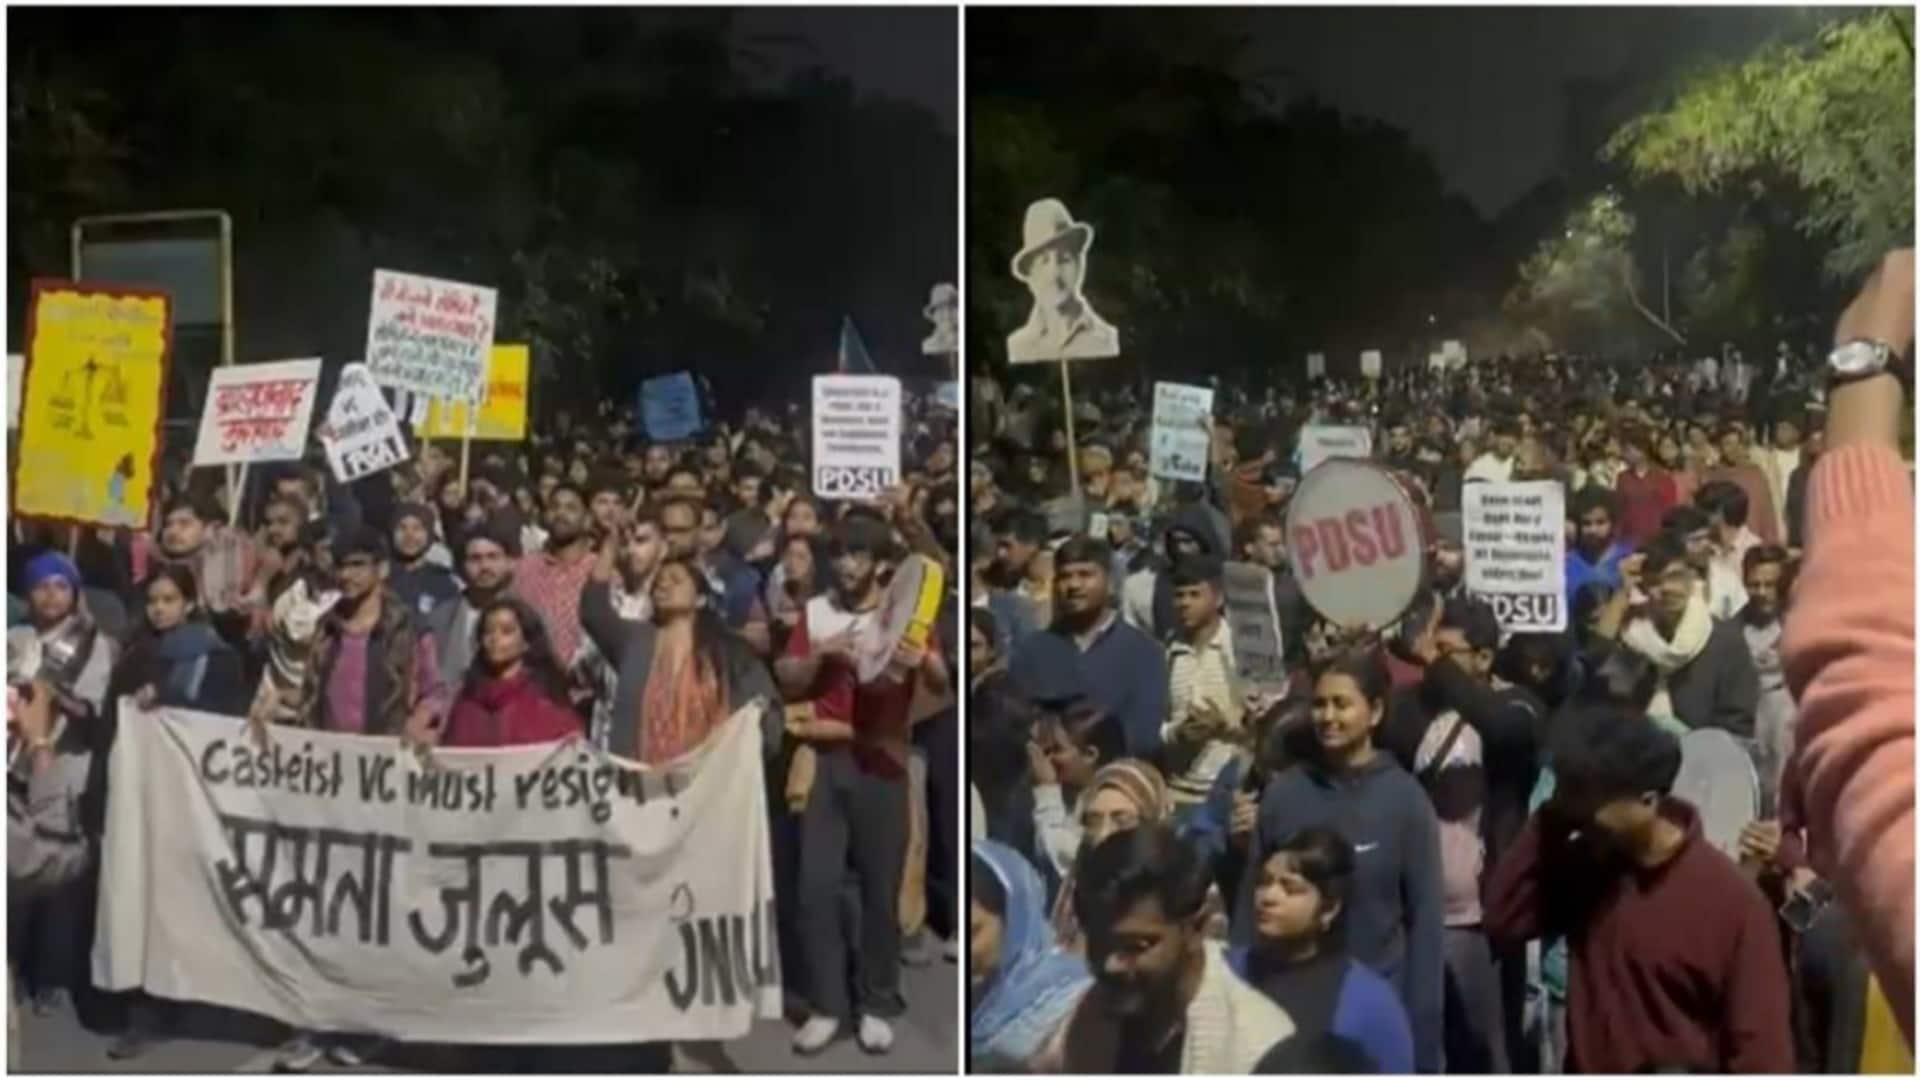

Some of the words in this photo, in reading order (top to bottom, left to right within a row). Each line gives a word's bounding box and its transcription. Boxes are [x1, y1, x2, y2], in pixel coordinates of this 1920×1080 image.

[1295, 502, 1404, 579] PDSU
[358, 753, 396, 803] VC
[514, 753, 646, 823] resign
[214, 813, 412, 947] समता
[408, 838, 632, 989] जुलूस
